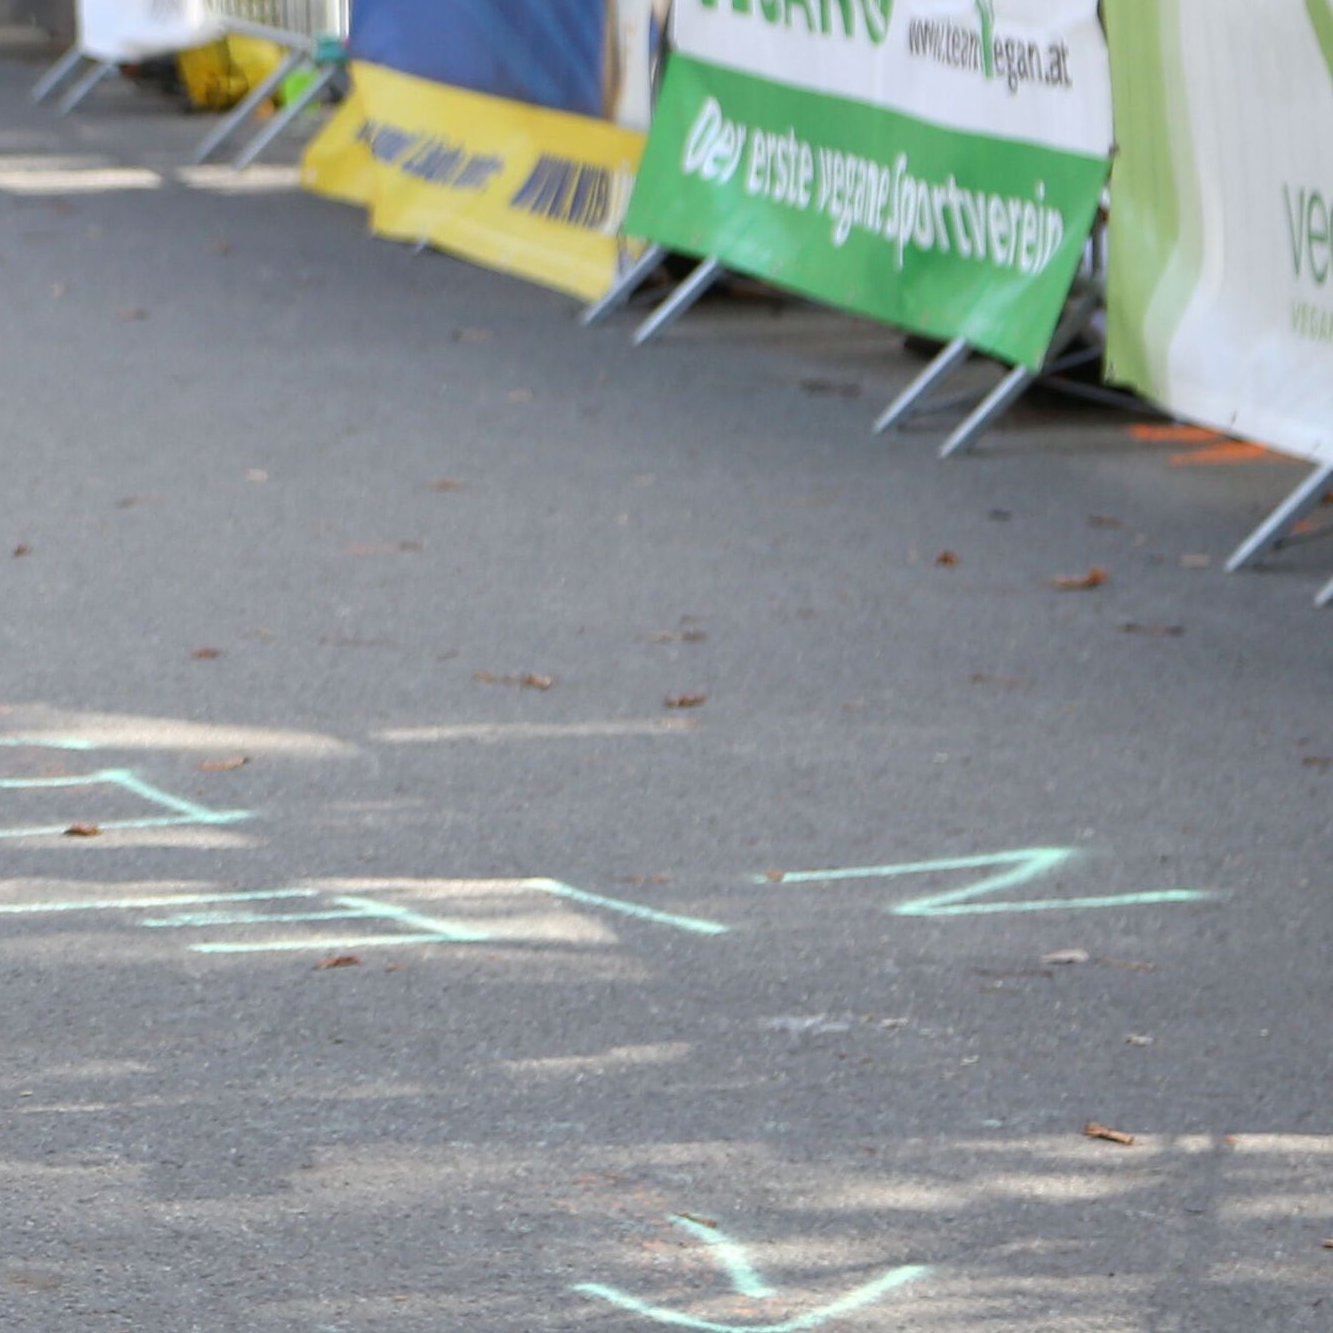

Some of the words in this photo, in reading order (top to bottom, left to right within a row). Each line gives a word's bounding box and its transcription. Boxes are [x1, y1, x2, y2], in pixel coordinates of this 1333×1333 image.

[682, 96, 746, 185] Der
[745, 125, 813, 210] erste
[885, 151, 1065, 273] Sportverein
[1282, 181, 1333, 285] ve
